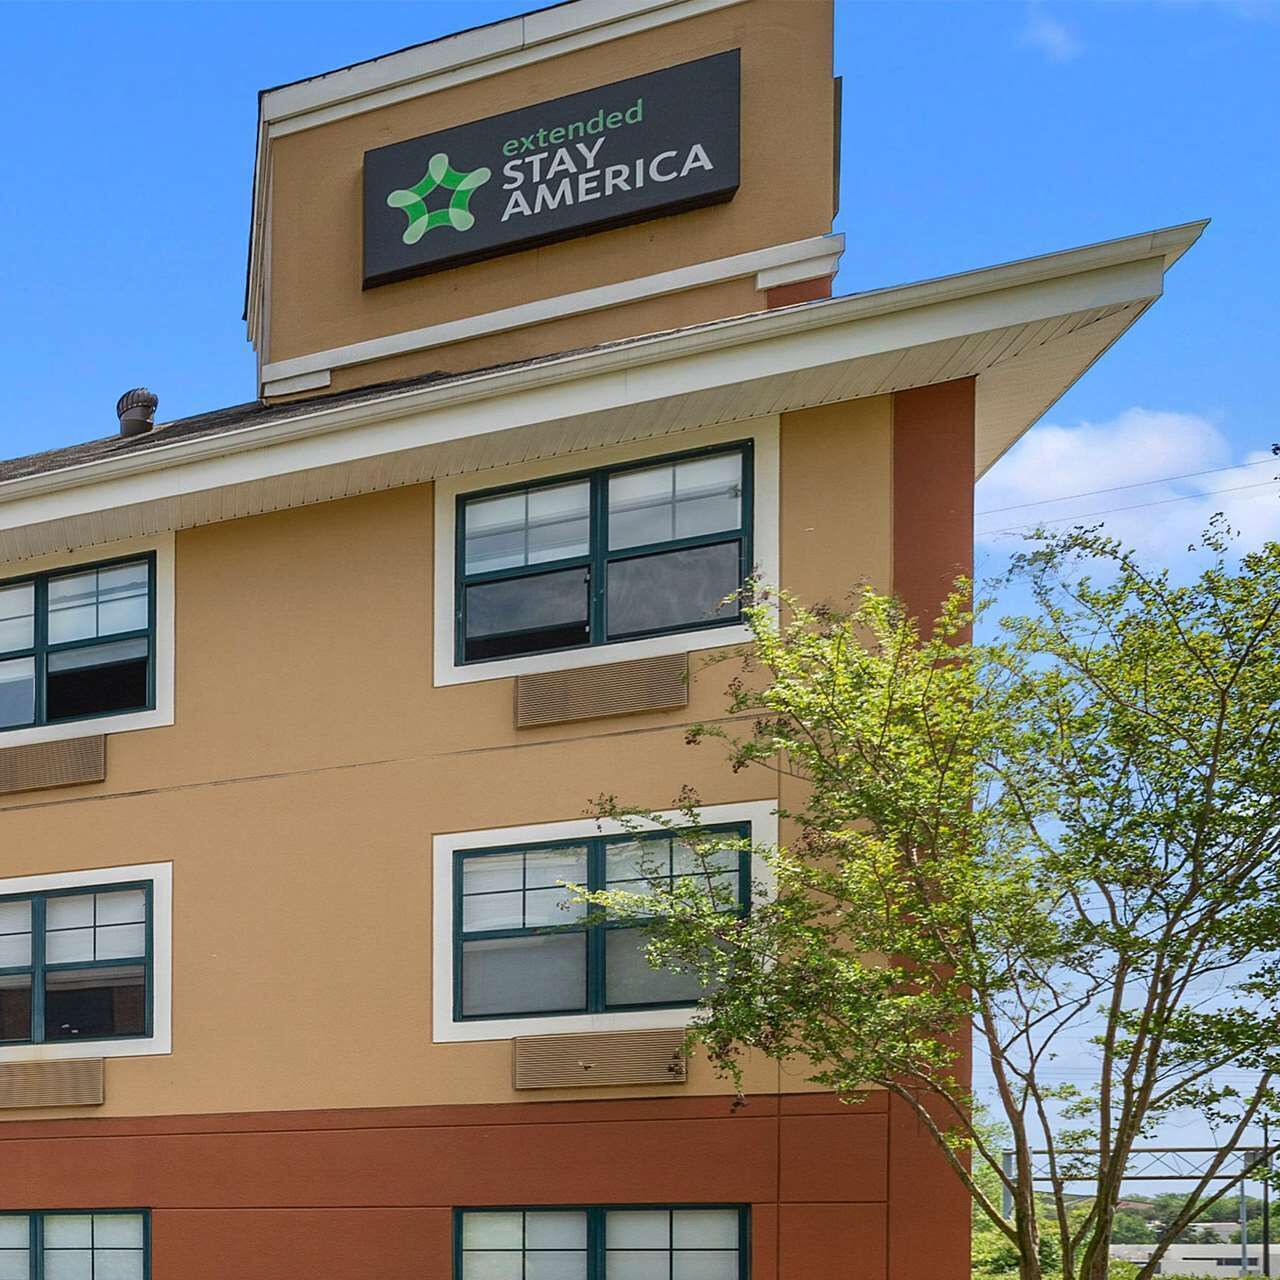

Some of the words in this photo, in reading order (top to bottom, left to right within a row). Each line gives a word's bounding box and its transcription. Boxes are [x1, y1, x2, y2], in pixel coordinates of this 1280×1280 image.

[502, 98, 643, 157] extended
[501, 143, 715, 222] AMERICA
[502, 136, 606, 190] STAY
